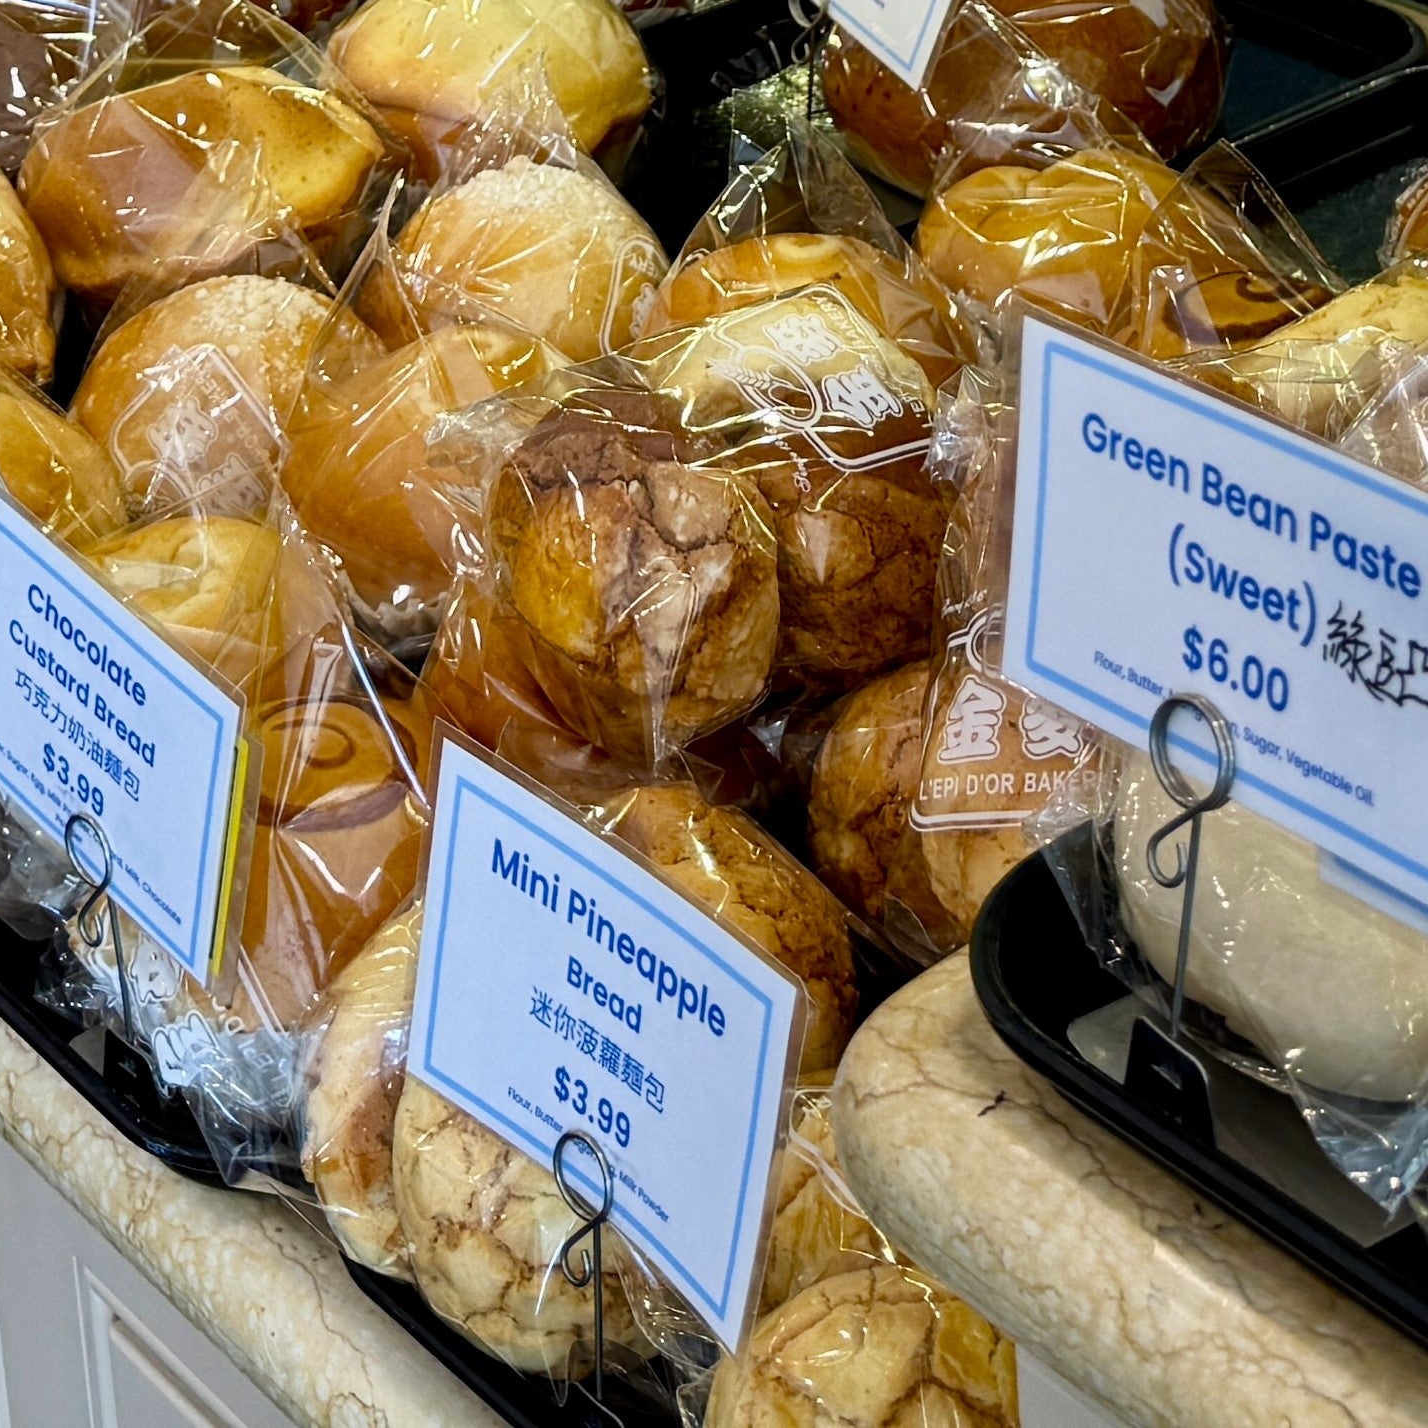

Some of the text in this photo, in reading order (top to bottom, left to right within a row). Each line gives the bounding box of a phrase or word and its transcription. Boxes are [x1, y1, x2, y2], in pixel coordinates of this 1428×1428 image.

[1081, 412, 1423, 601] Green Bean Paste
[1168, 522, 1318, 648] (Sweet)
[26, 581, 149, 709] Chocolate
[1094, 650, 1126, 681] Flour,
[1182, 624, 1290, 715] $6.00
[8, 617, 157, 770] Custard Bread
[13, 668, 143, 804] 巧克力奶油麵包
[41, 742, 106, 817] $3.99
[918, 770, 1015, 803] L'EPI D'OR
[1242, 725, 1284, 762] Sugar,
[1285, 747, 1354, 797] Vegetable
[490, 837, 729, 1039] Mini Pineapple
[566, 955, 643, 1036] Bread
[527, 985, 667, 1115] 迷你菠蘿麵包
[508, 1086, 534, 1115] Flour,
[552, 1064, 633, 1151] $3.99
